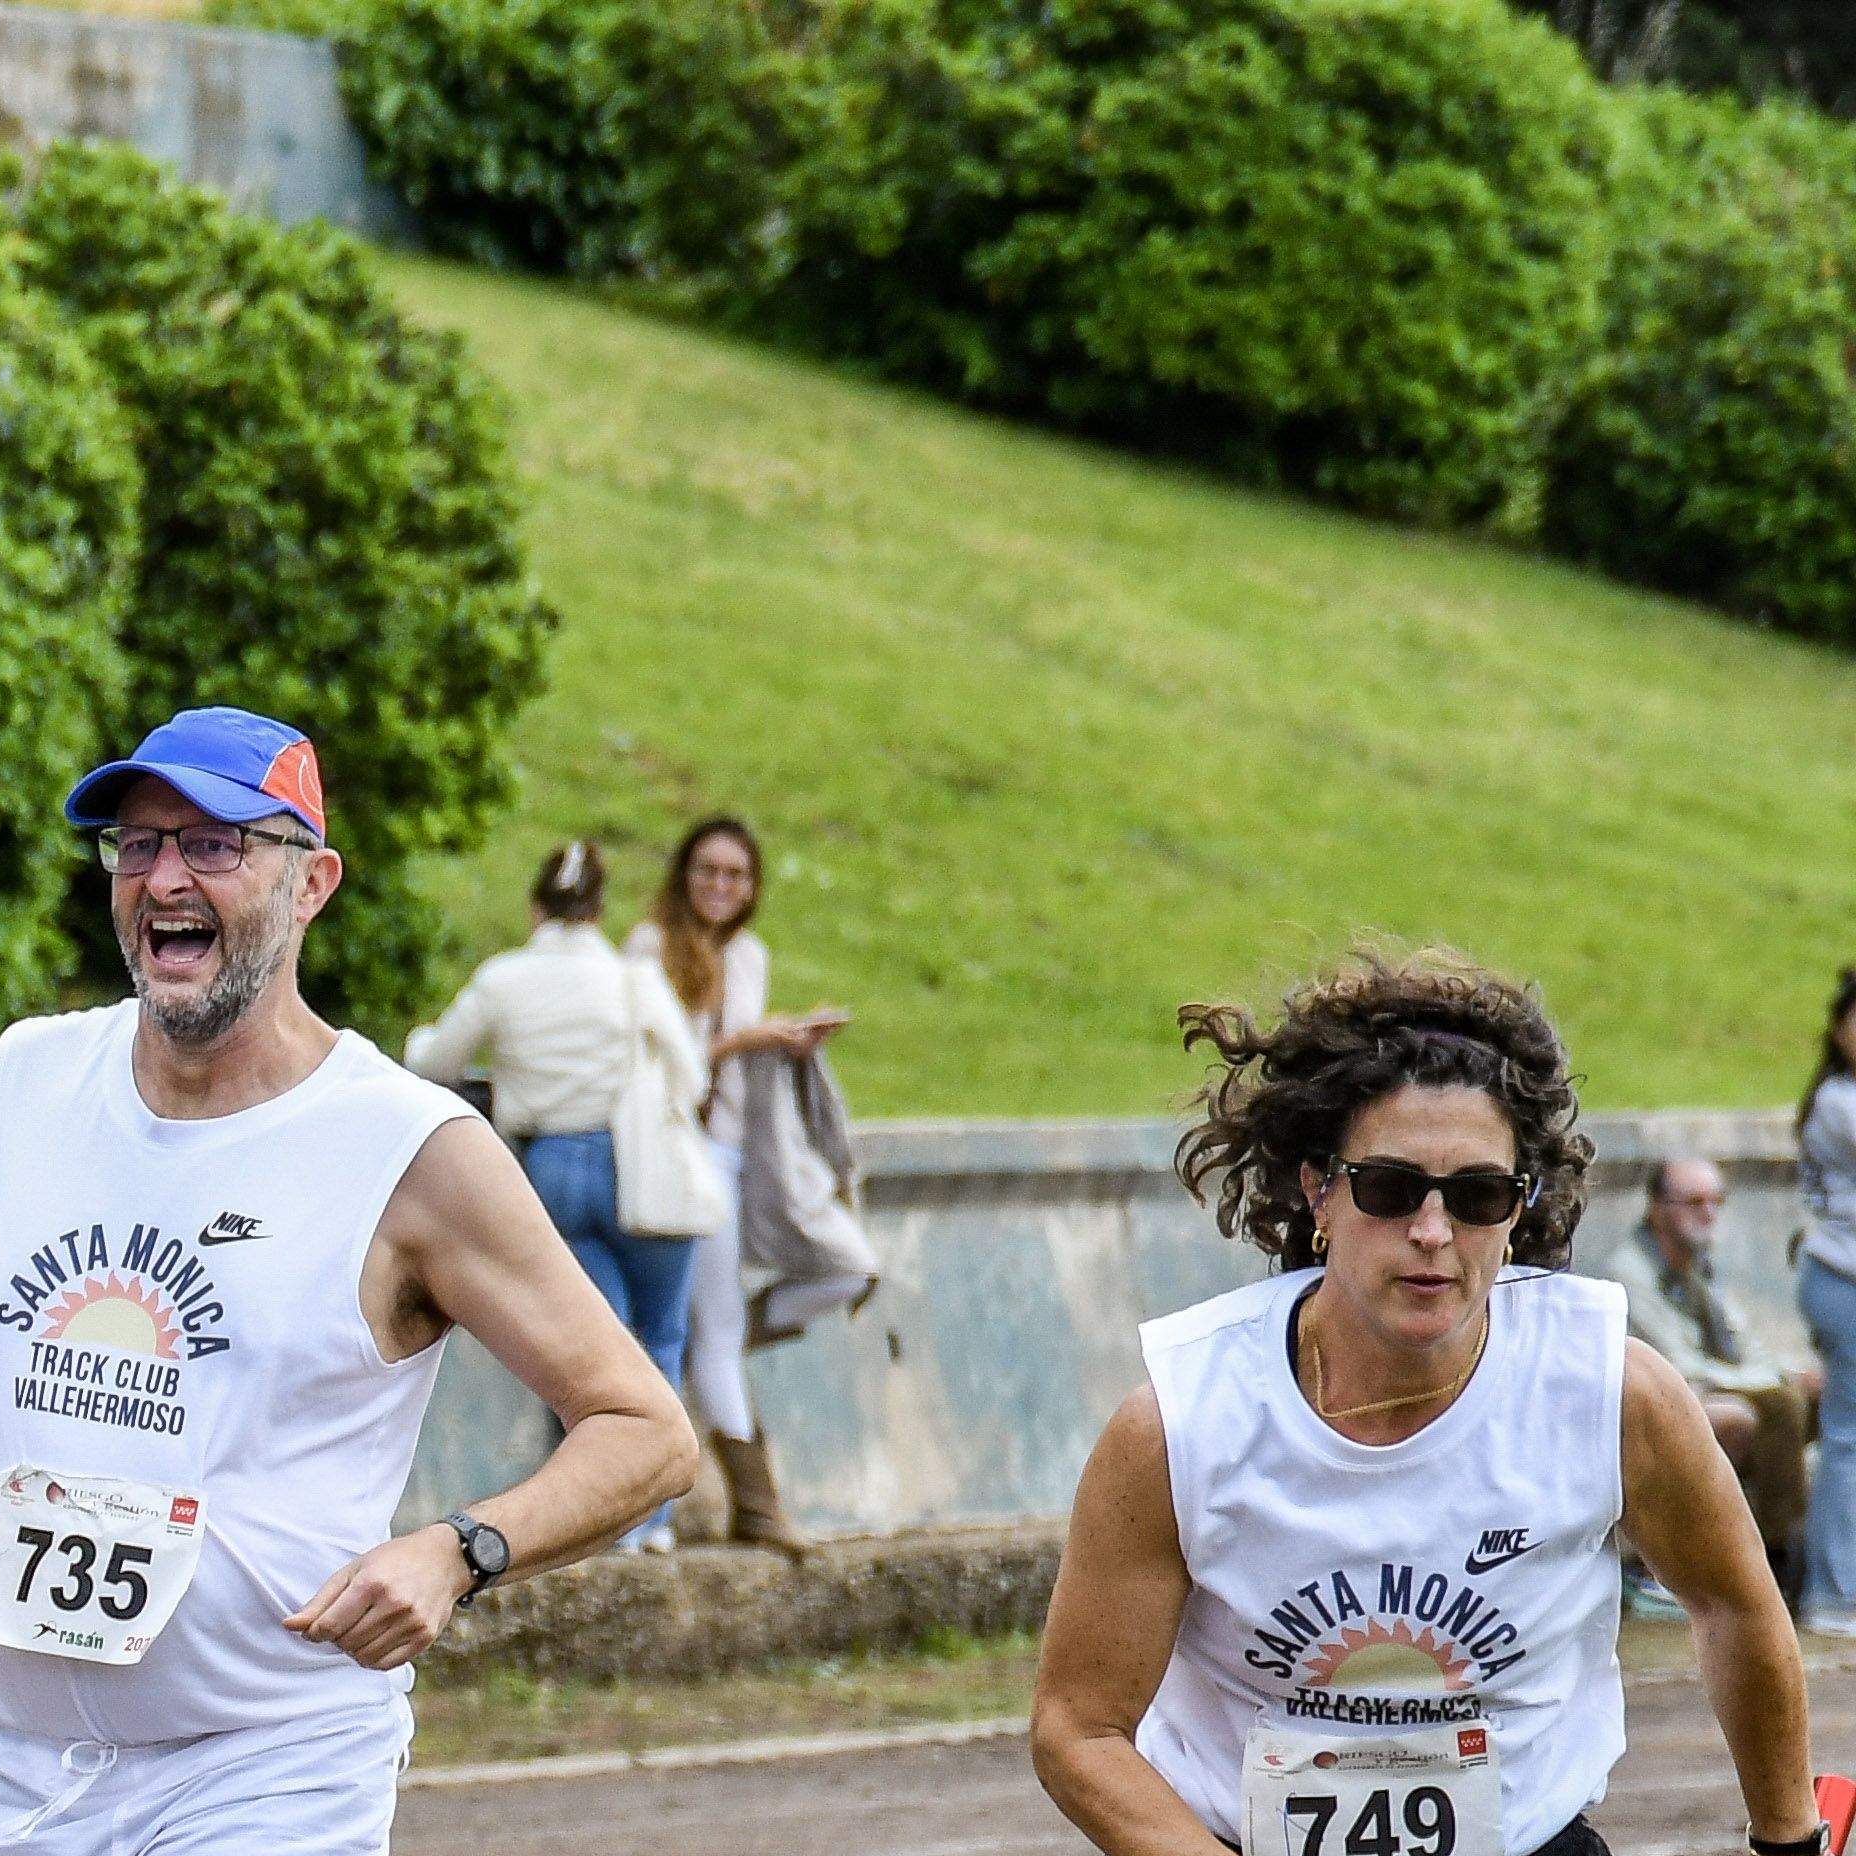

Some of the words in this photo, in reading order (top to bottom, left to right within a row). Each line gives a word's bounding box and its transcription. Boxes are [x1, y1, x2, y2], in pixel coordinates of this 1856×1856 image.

[211, 1211, 263, 1237] NIKE
[120, 1223, 231, 1361] MONICA
[30, 1341, 108, 1386] TRACK
[114, 1357, 181, 1398] CLUB
[14, 1377, 186, 1437] VALLEHERMOSO
[1476, 1528, 1530, 1555] NIKE
[15, 1525, 153, 1623] 735
[58, 1626, 104, 1650] rasán
[1244, 1569, 1366, 1680] SANTA
[1377, 1563, 1528, 1682] MONICA
